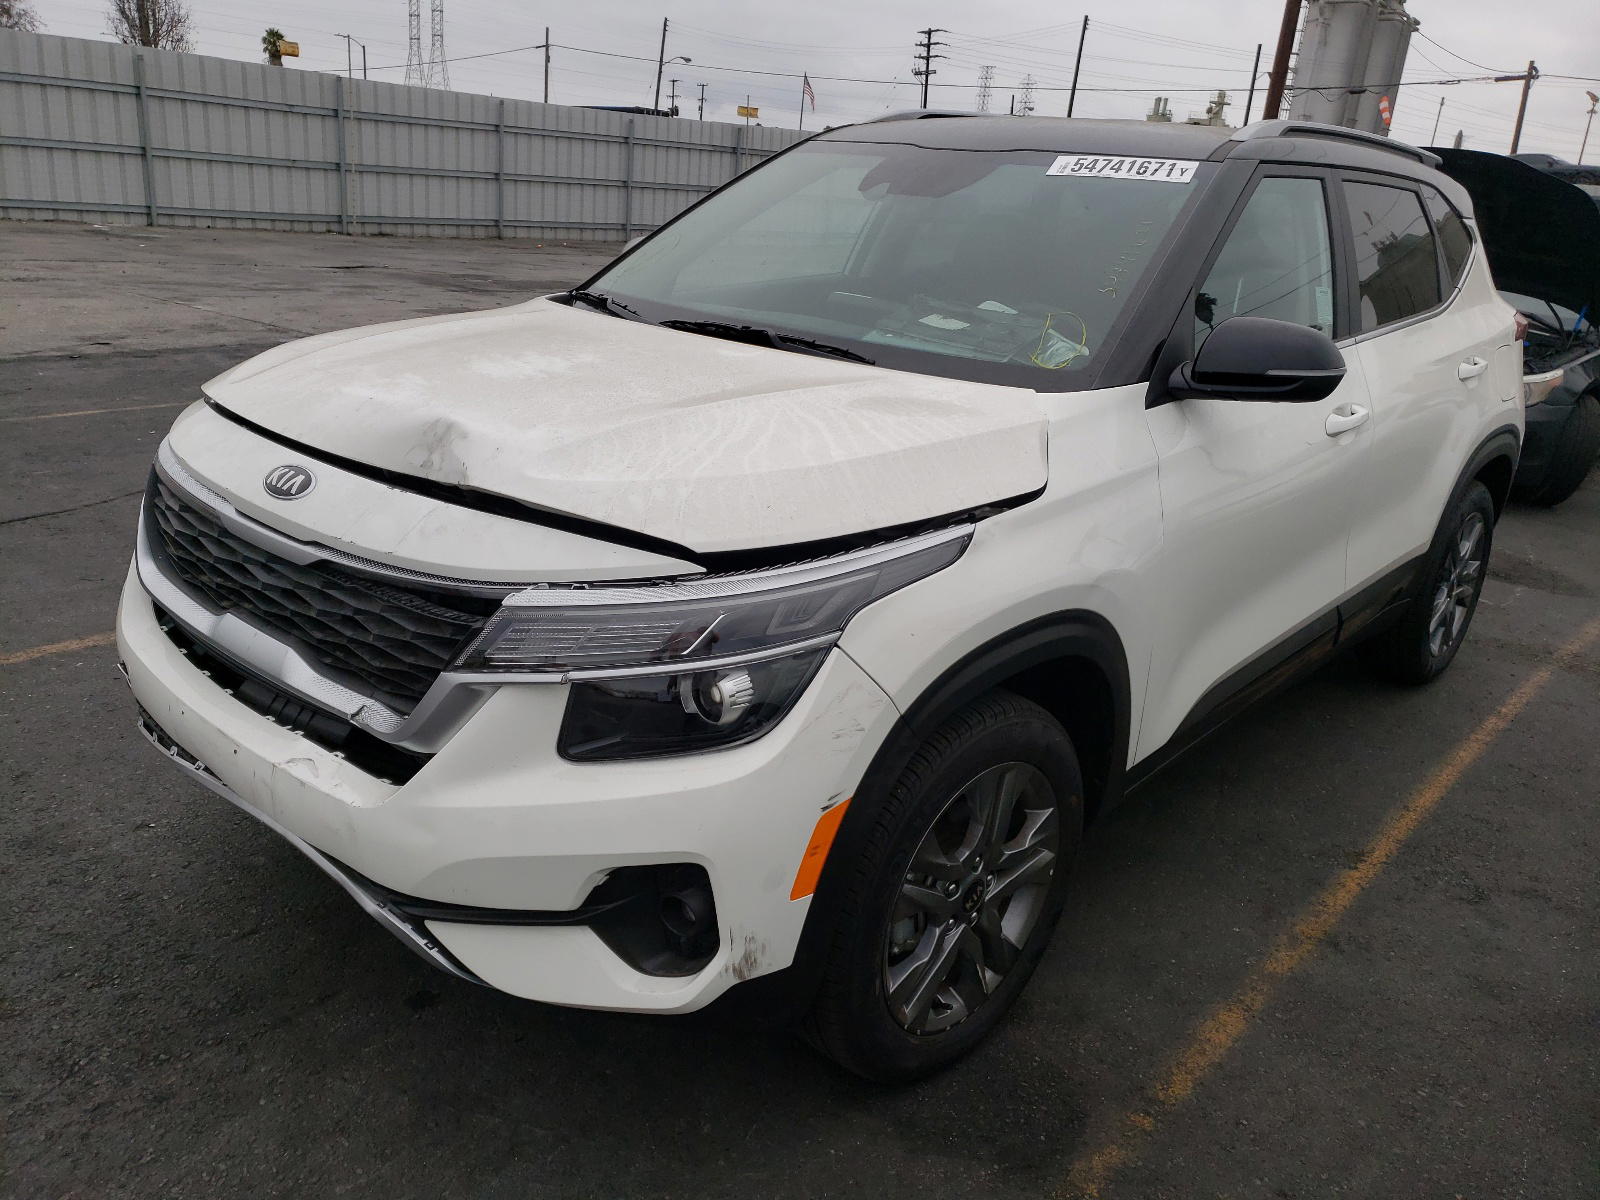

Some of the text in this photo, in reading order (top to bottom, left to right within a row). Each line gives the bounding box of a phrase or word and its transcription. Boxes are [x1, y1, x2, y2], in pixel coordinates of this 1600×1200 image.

[1070, 157, 1177, 178] 54741671
[266, 467, 306, 495] KIA
[965, 885, 983, 909] KIA
